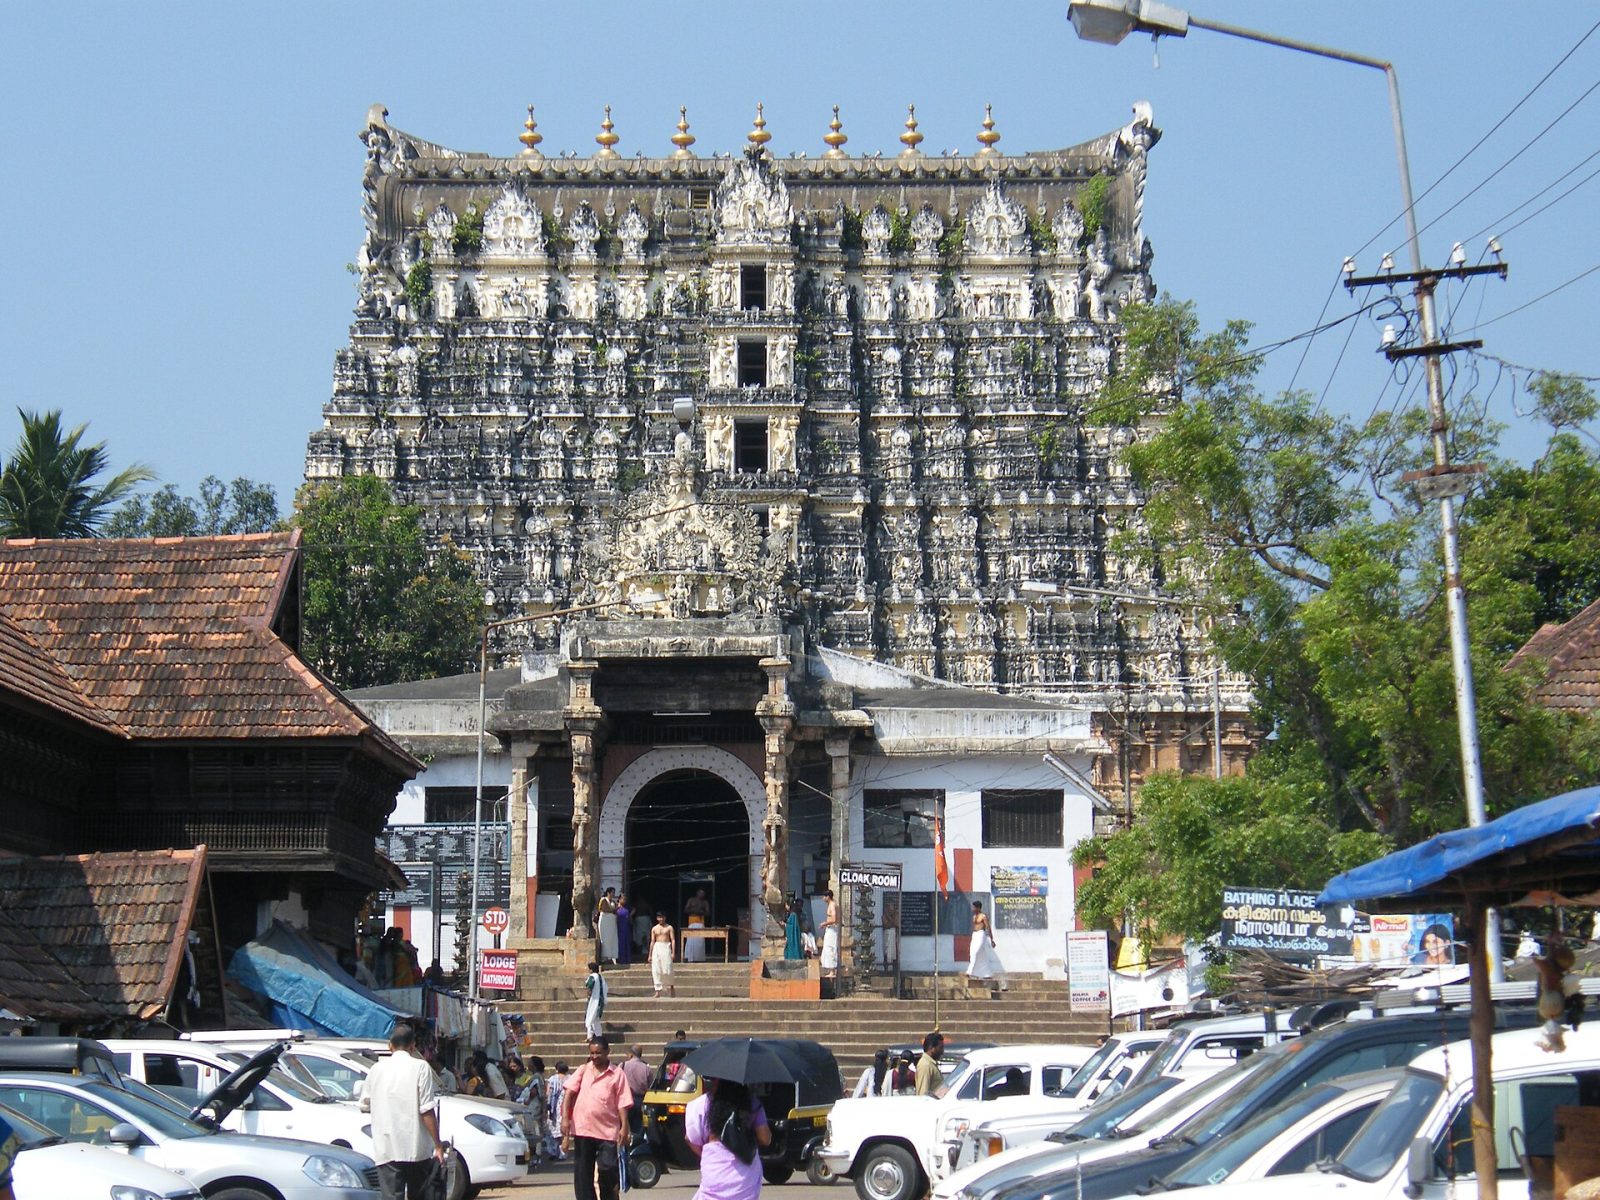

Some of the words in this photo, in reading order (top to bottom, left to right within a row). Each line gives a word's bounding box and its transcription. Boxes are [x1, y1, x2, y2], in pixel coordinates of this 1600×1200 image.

[841, 871, 870, 884] CLOAK
[872, 875, 897, 887] ROOM
[1223, 891, 1276, 906] BATHING
[1279, 893, 1316, 908] PLACE
[485, 910, 507, 925] STD
[1375, 922, 1407, 931] Nirmal
[484, 955, 516, 969] LODGE
[482, 973, 514, 986] BATHROOM
